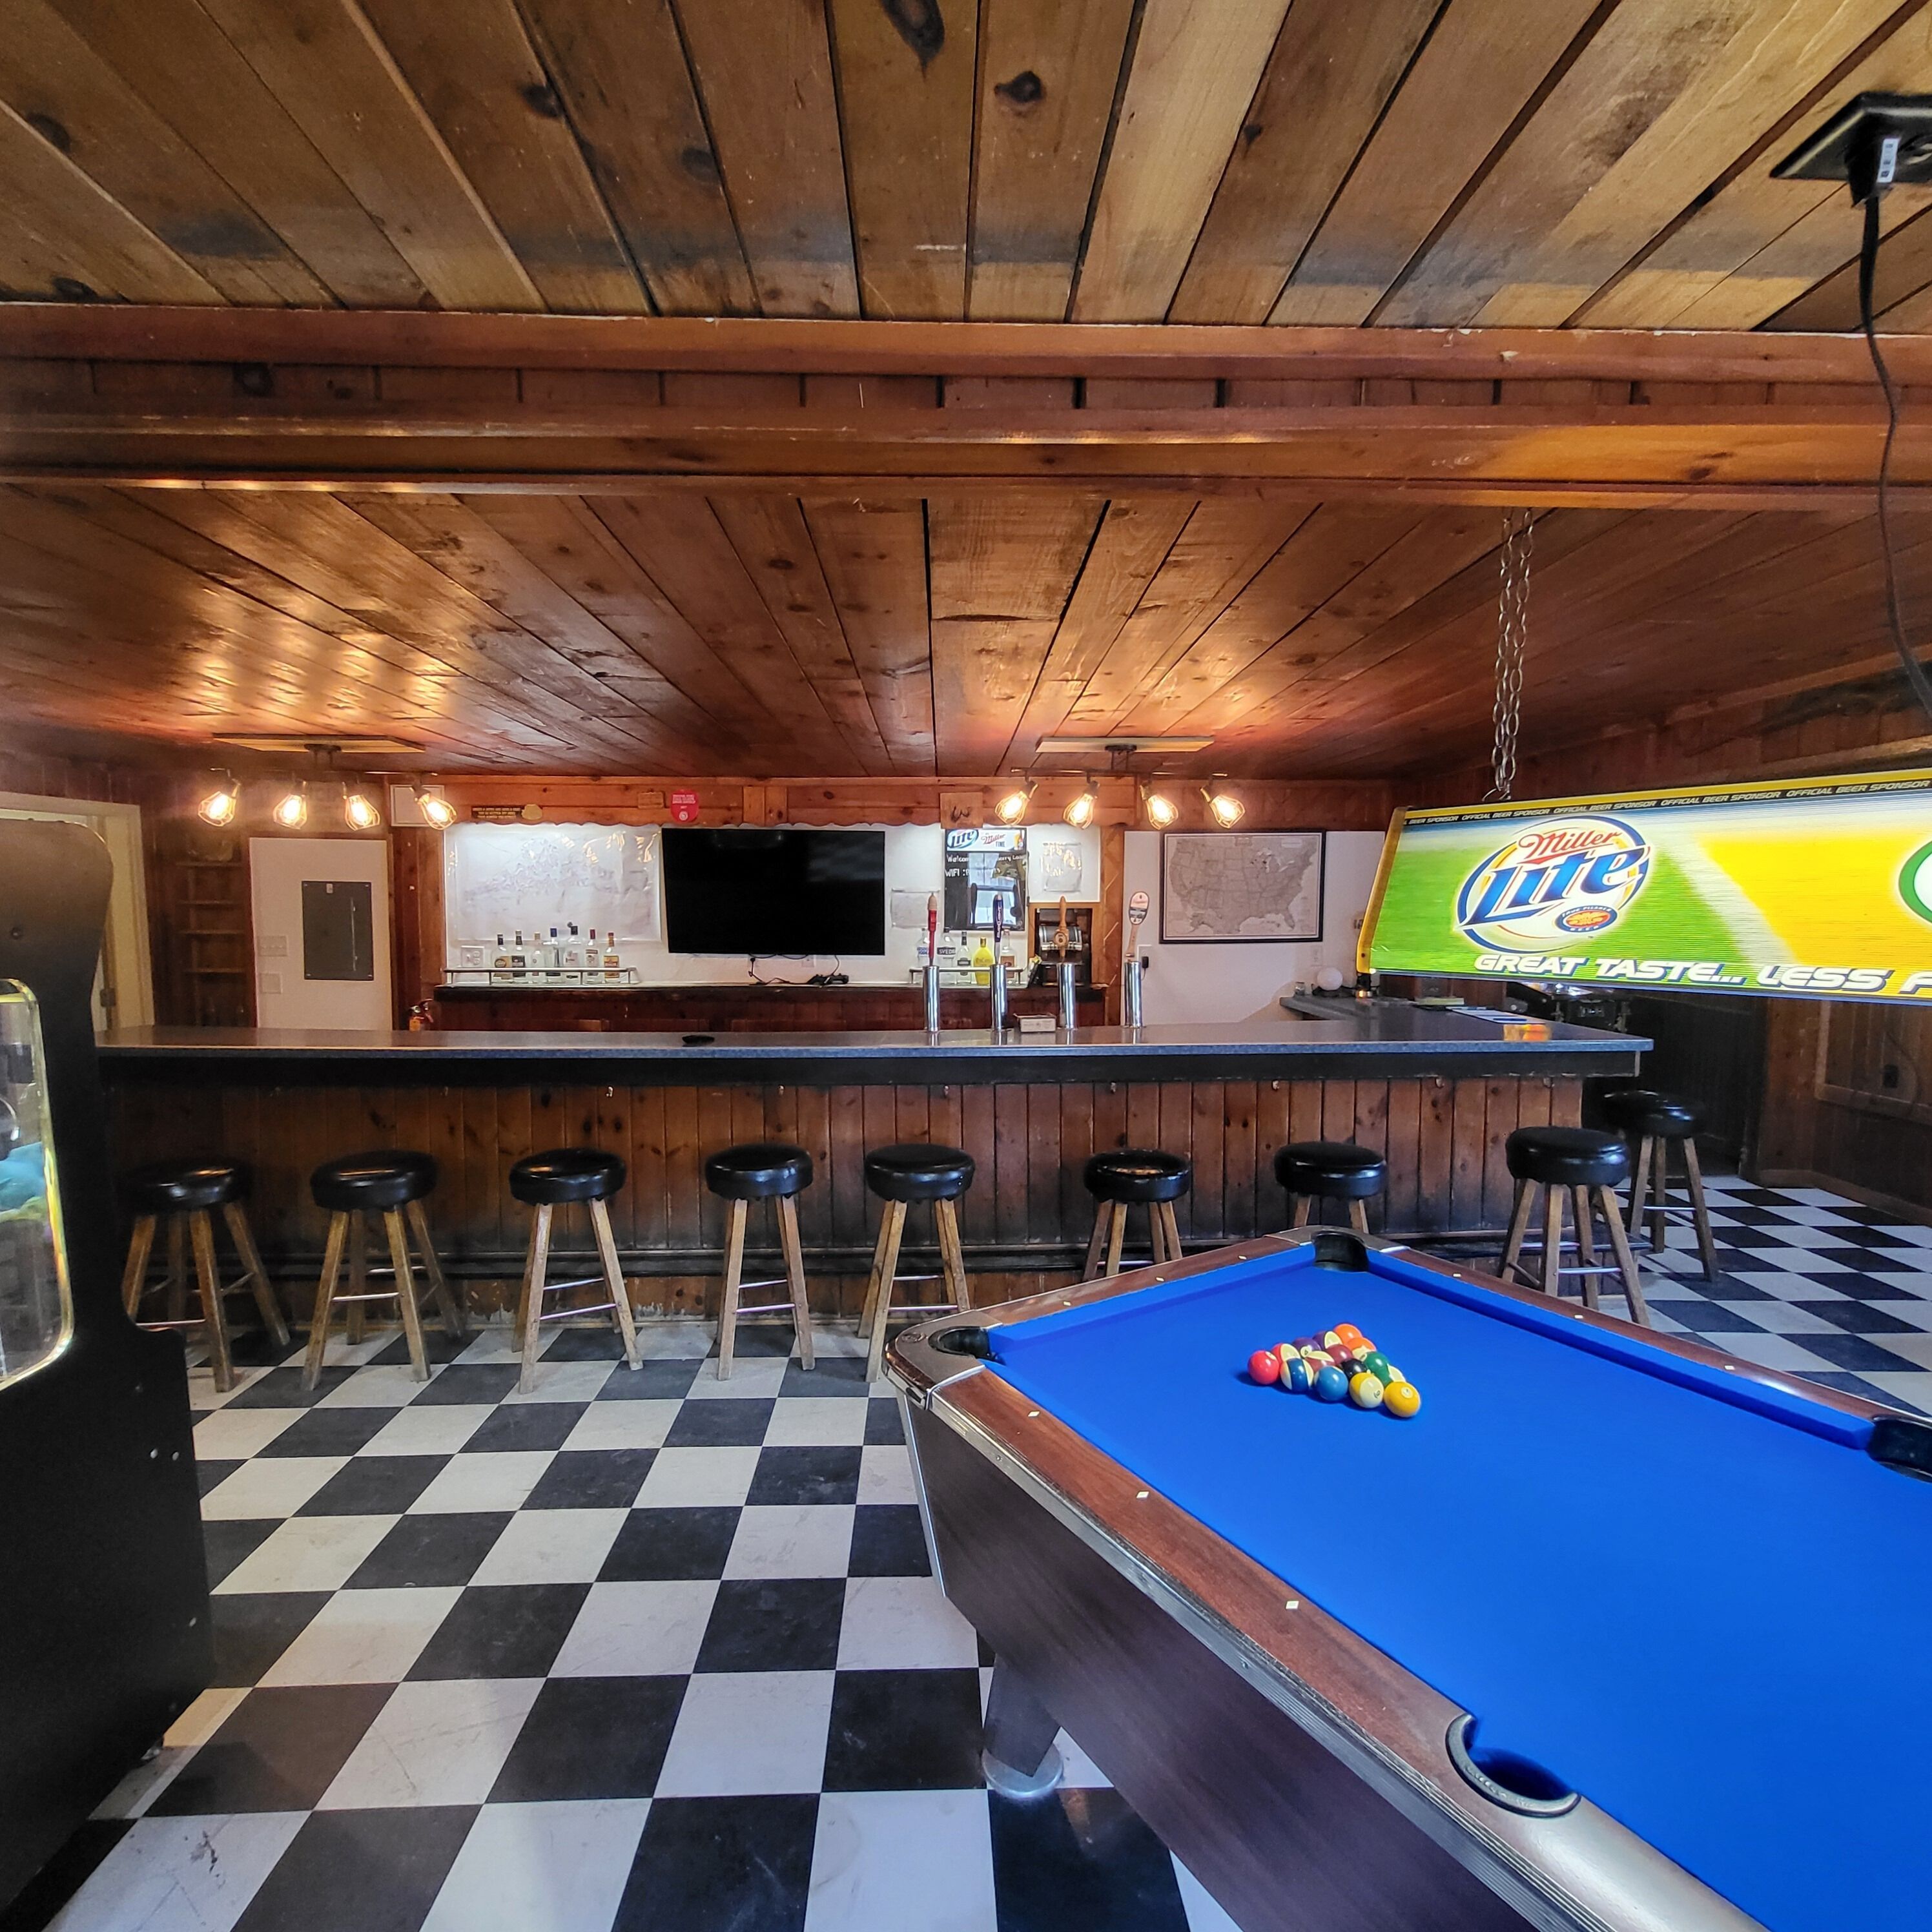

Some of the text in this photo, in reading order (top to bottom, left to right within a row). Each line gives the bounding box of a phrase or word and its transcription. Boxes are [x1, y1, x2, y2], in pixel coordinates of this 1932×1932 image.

[1786, 780, 1931, 797] OFFICIAL BEER SPONSOR
[1612, 801, 1657, 809] SPONSOR
[1660, 792, 1782, 806] OFFICIAL BEER SPONSOR
[1513, 808, 1550, 817] SPONSOR
[1518, 830, 1622, 865] Miller
[1461, 847, 1645, 926] Lite
[1474, 954, 1588, 977] GREAT
[1596, 958, 1746, 985] TASTE...
[1756, 965, 1895, 992] LESS
